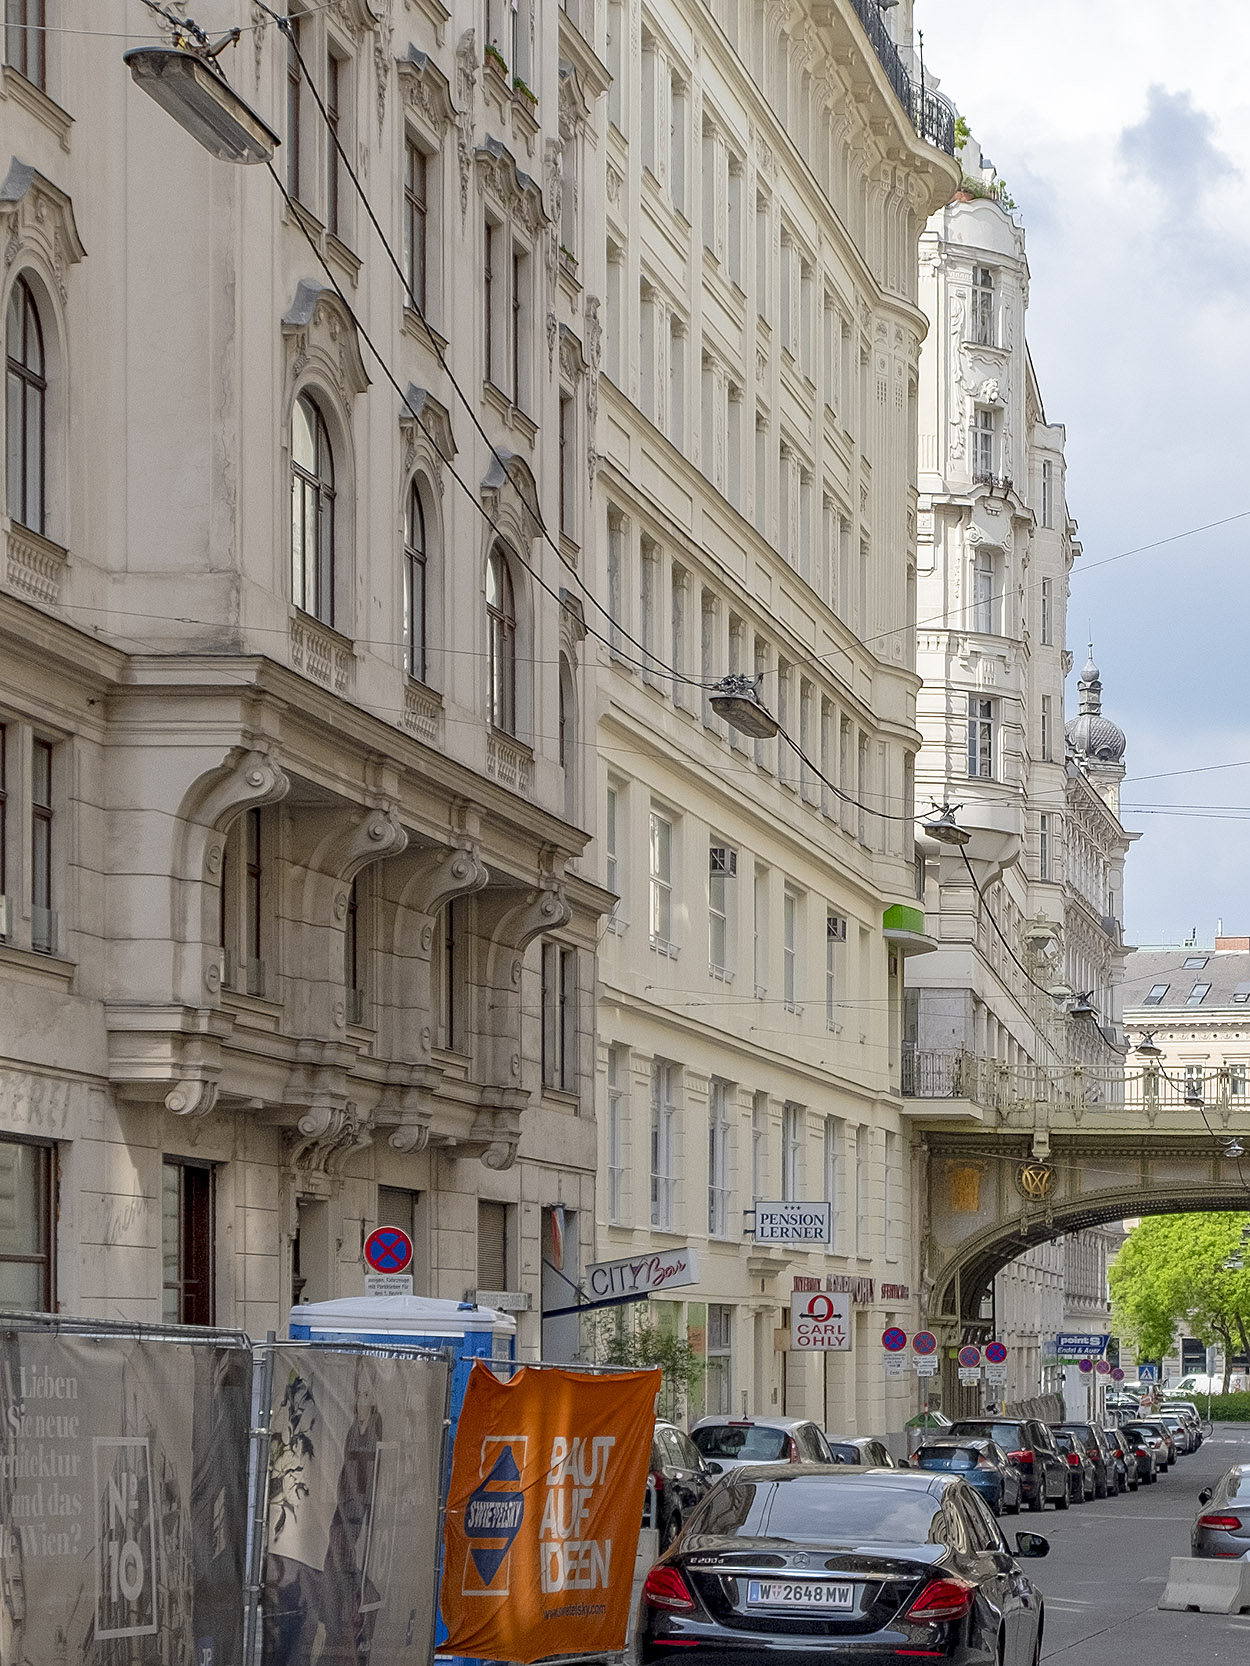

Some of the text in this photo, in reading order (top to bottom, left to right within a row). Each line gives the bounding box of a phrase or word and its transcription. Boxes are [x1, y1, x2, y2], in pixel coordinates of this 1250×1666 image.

[760, 1213, 825, 1226] PENSION
[760, 1226, 824, 1238] LERNER
[592, 1256, 686, 1295] CITY Bar
[797, 1324, 846, 1335] CARL
[797, 1336, 846, 1346] OHLY
[20, 1365, 78, 1399] Lieben
[8, 1404, 79, 1438] Sie neue
[546, 1436, 615, 1486] BAUT
[12, 1483, 81, 1517] und das
[468, 1501, 523, 1529] SWIETELSKY
[538, 1488, 594, 1539] AUF
[109, 1539, 144, 1602] 10
[539, 1539, 611, 1594] IDEEN
[760, 1584, 849, 1603] W 2648 MW
